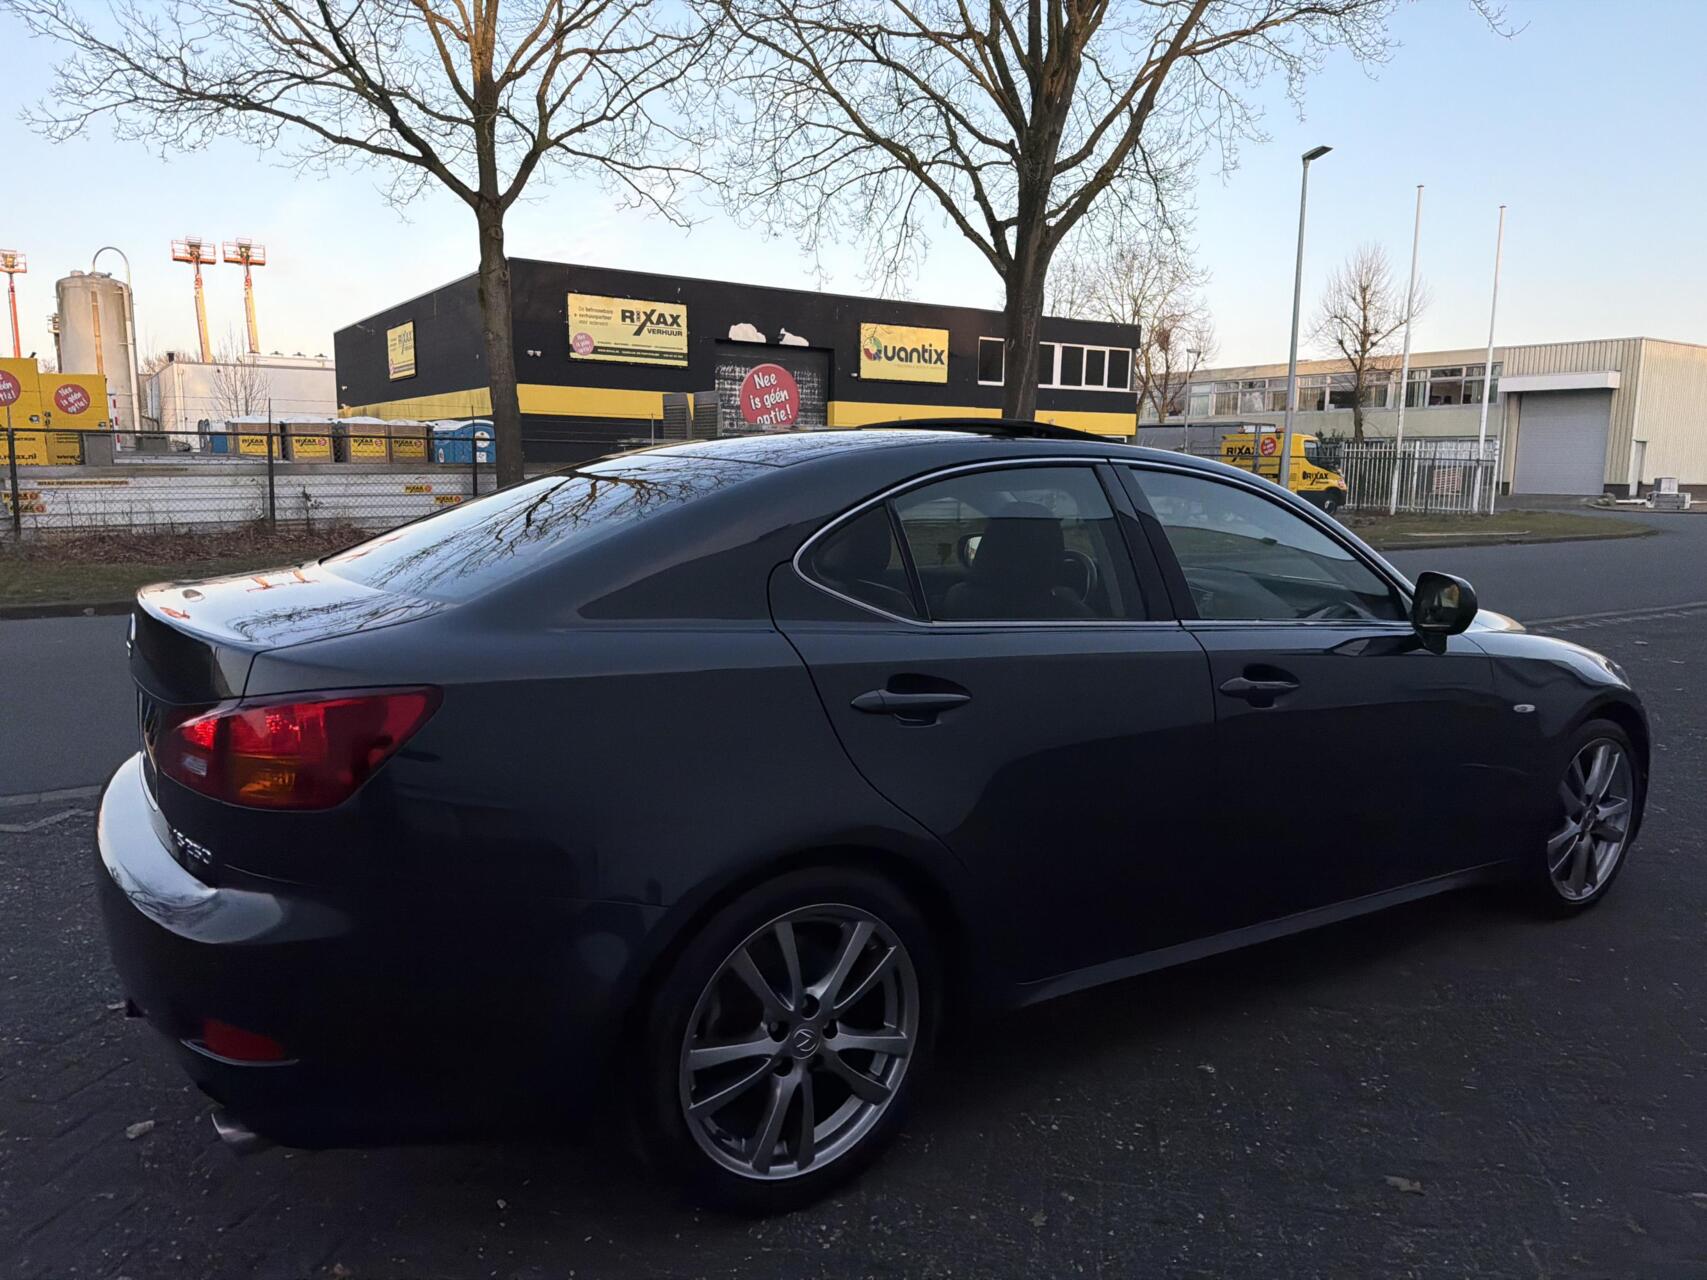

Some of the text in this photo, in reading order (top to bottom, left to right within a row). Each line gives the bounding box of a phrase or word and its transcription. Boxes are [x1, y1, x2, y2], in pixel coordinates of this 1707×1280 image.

[621, 309, 682, 337] RIXAX
[647, 327, 683, 337] VERHUUR
[753, 372, 777, 390] Nee
[749, 387, 789, 410] is géén
